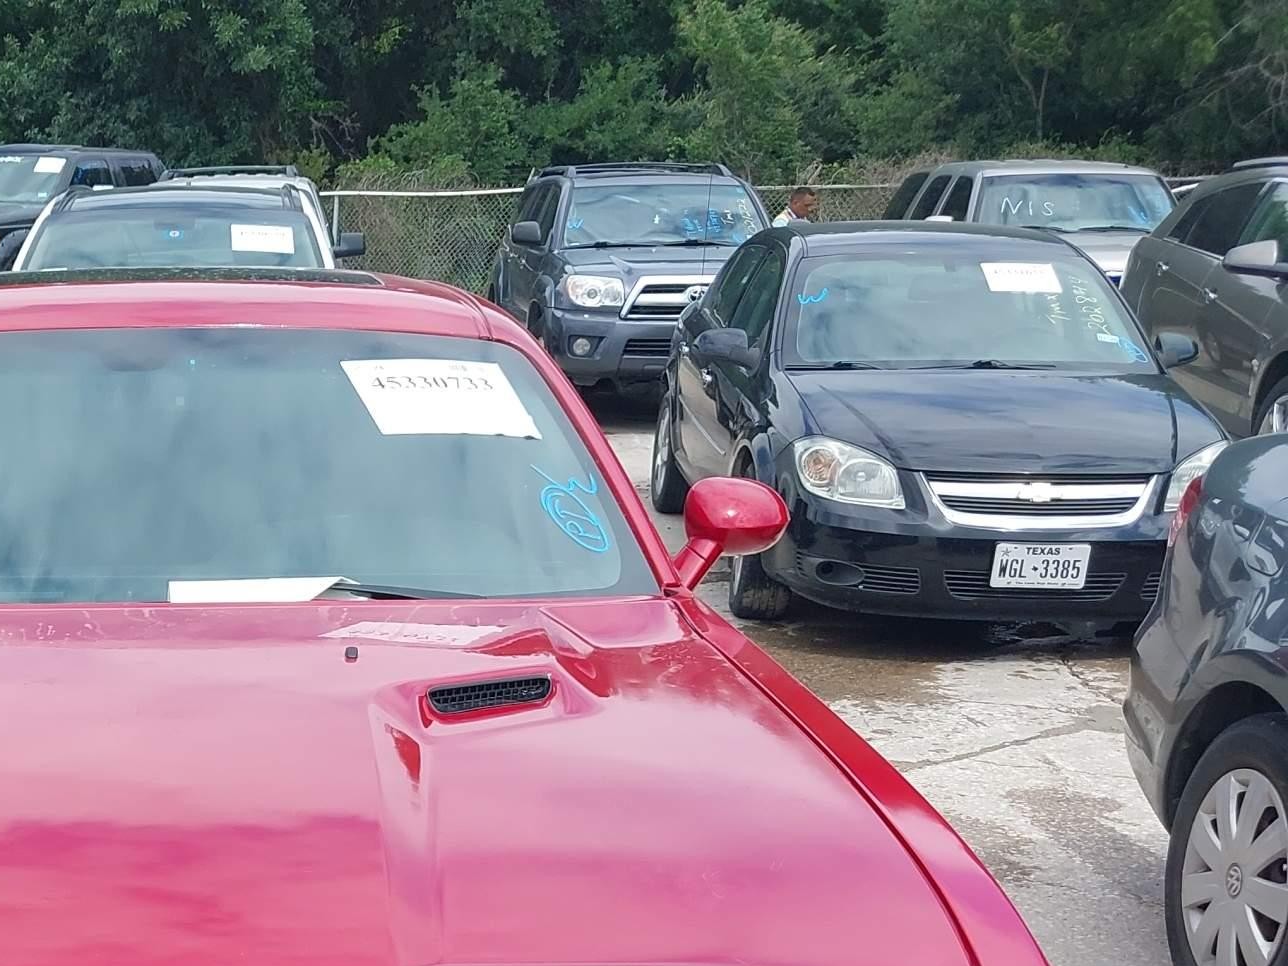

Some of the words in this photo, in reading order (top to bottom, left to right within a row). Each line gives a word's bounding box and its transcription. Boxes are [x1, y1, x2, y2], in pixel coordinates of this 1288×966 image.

[370, 375, 494, 391] 45330733
[1026, 546, 1061, 556] TEXAS
[998, 558, 1027, 579] WGL
[1039, 559, 1082, 580] 3385
